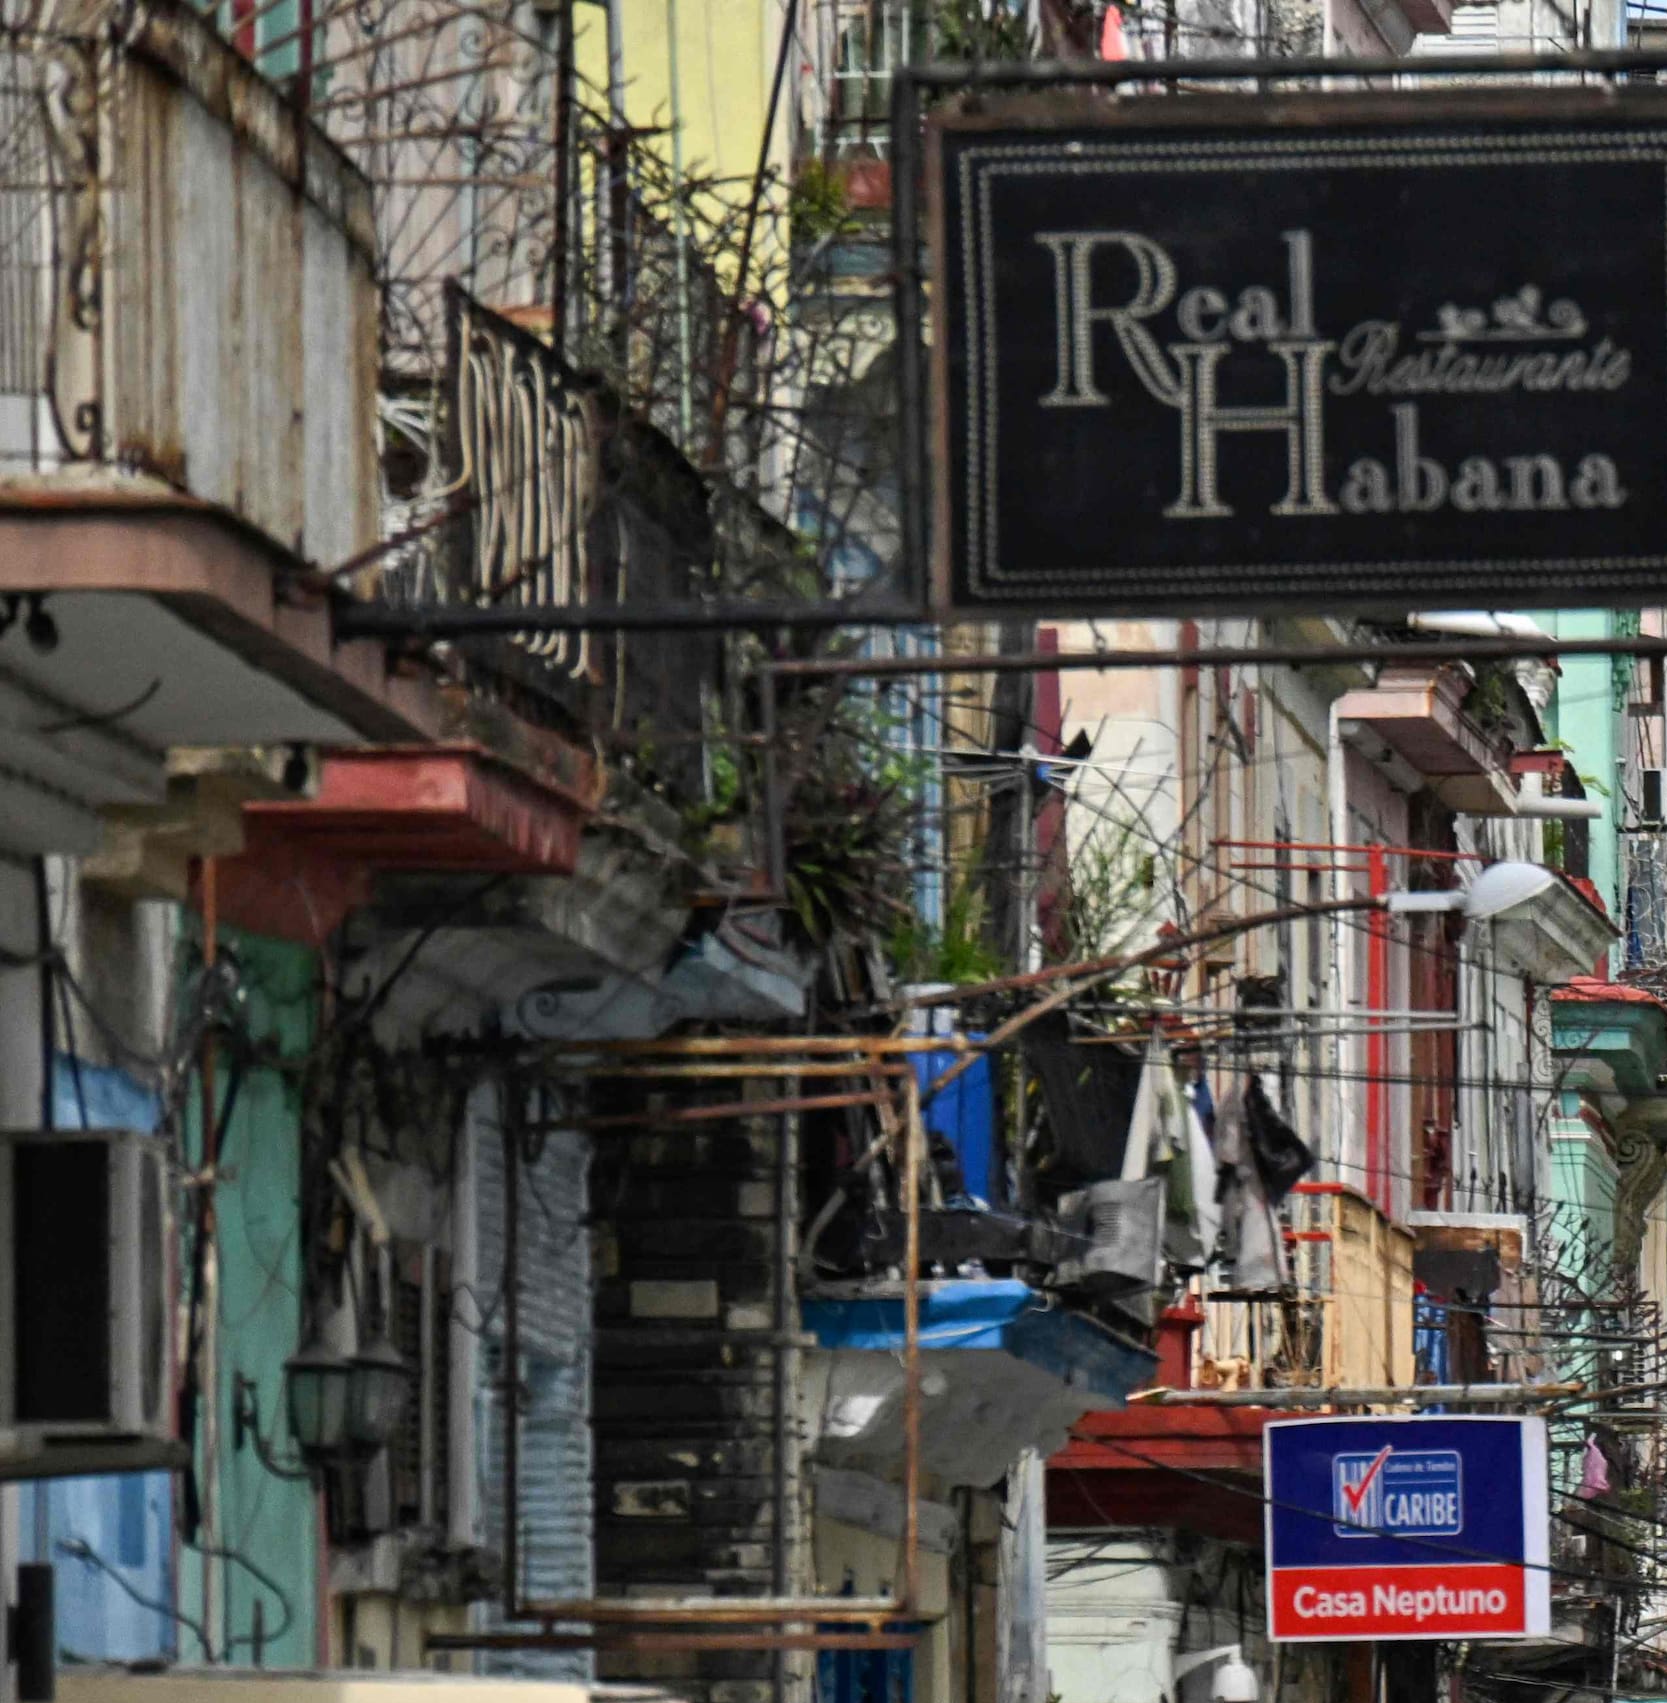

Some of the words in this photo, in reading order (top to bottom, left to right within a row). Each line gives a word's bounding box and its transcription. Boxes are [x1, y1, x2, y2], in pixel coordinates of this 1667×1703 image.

[1034, 229, 1320, 408] Real
[1328, 319, 1633, 396] Restaurante
[1164, 341, 1626, 519] Habana
[1384, 1493, 1457, 1526] CARIBE
[1293, 1585, 1365, 1618] Casa
[1374, 1583, 1506, 1621] Neptuno
